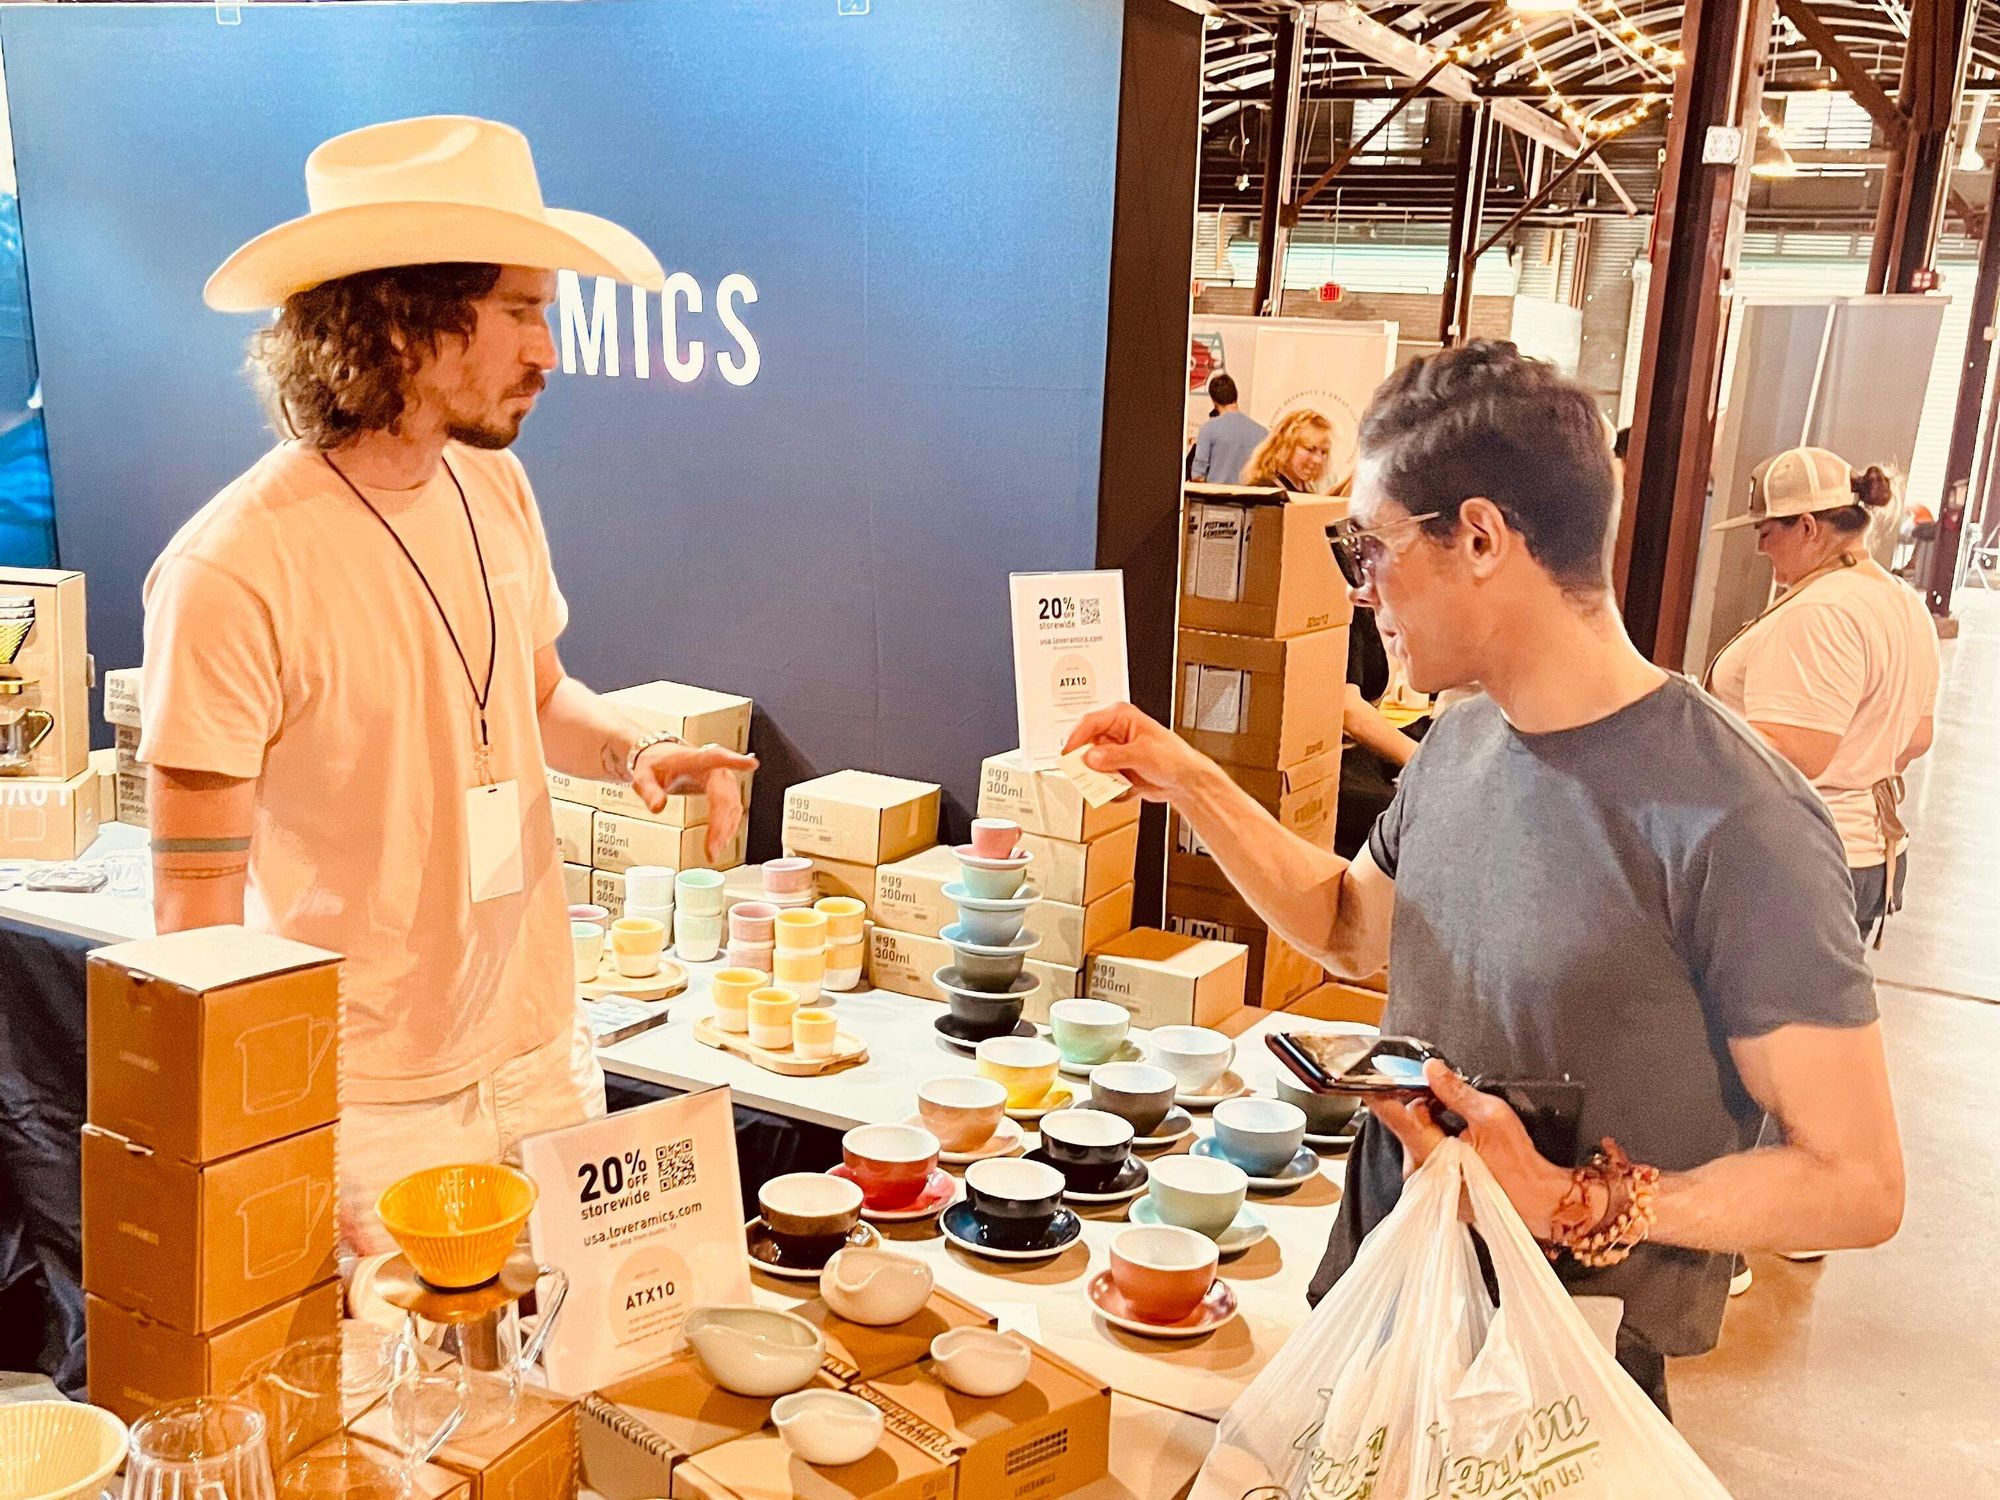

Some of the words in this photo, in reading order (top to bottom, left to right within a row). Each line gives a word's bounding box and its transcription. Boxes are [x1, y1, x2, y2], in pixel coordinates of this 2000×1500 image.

[1039, 596, 1075, 620] 20%
[1039, 620, 1075, 630] storewide
[1060, 676, 1087, 688] ATX10
[552, 774, 570, 787] cup
[988, 767, 1010, 783] egg
[601, 787, 624, 799] rose
[986, 781, 1023, 798] 300ml
[789, 797, 810, 810] egg
[788, 809, 823, 825] 300ml
[598, 820, 616, 833] egg
[597, 846, 619, 858] rose
[597, 879, 615, 891] egg
[881, 874, 902, 888] egg
[880, 887, 916, 903] 300ml
[875, 934, 896, 948] egg
[875, 948, 910, 964] 300ml
[1092, 976, 1130, 995] 300ml
[578, 1149, 647, 1203] 20%
[627, 1173, 648, 1189] OFF
[581, 1190, 650, 1220] storewide
[583, 1202, 702, 1247] usa.loveramics.com
[625, 1281, 675, 1311] ATX10
